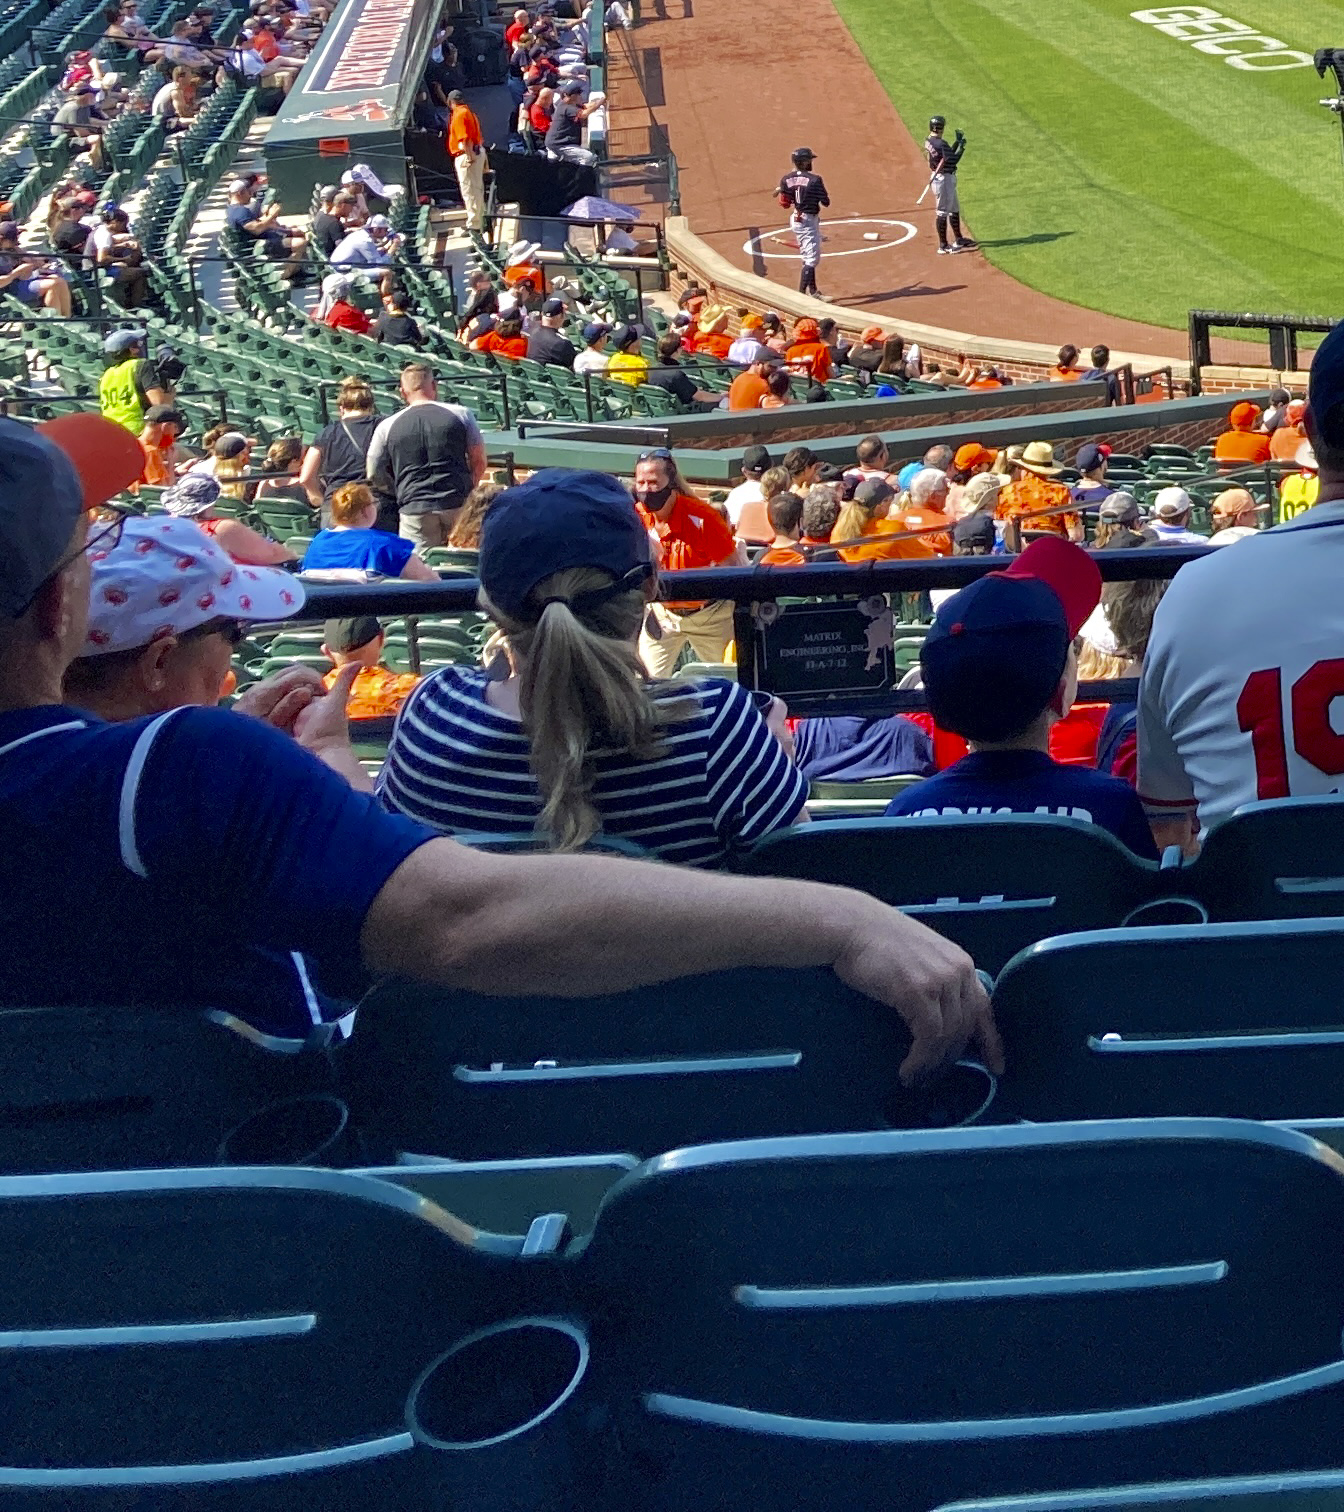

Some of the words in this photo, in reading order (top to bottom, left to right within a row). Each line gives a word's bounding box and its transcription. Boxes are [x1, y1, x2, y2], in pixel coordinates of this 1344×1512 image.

[1130, 5, 1315, 71] GEICO
[795, 185, 801, 204] 1
[804, 631, 842, 642] MATRIX
